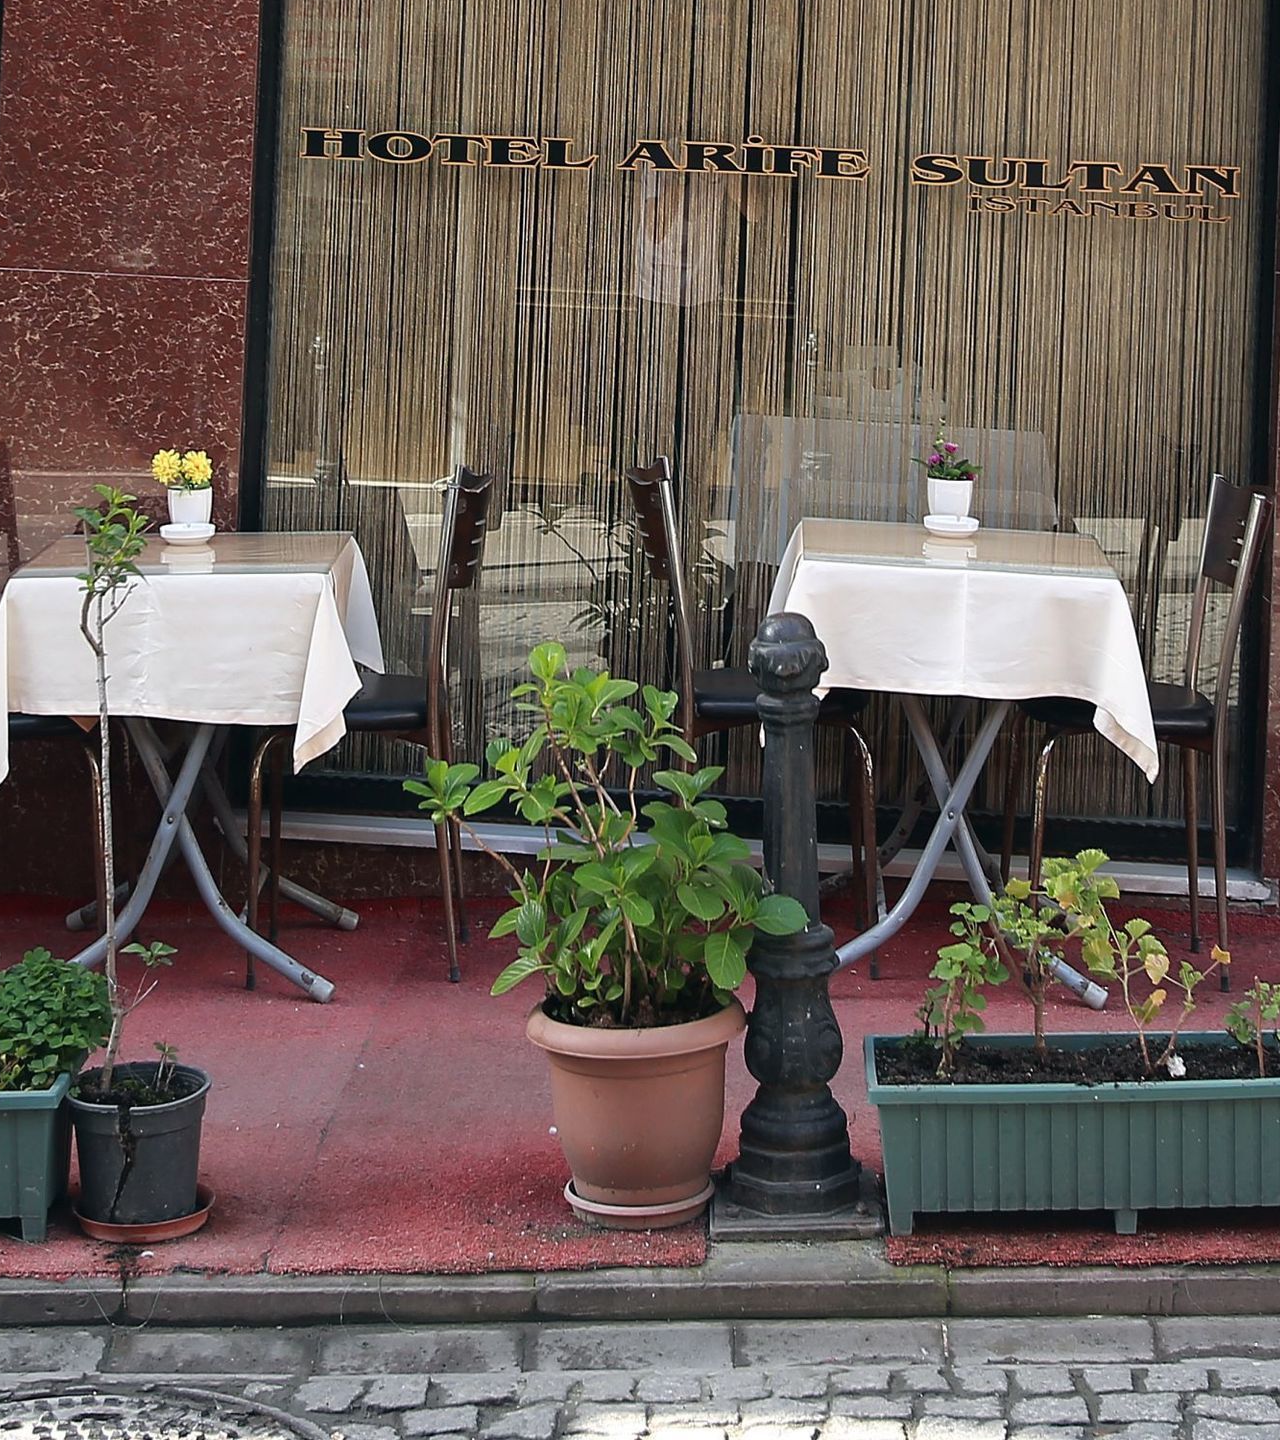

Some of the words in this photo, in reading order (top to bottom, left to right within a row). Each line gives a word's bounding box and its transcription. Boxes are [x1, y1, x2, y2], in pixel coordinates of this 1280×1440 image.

[298, 126, 599, 170] HOTEL
[616, 134, 871, 182] ARİFE
[910, 153, 1240, 198] SULTAN
[967, 190, 1233, 223] İSTANBUL
